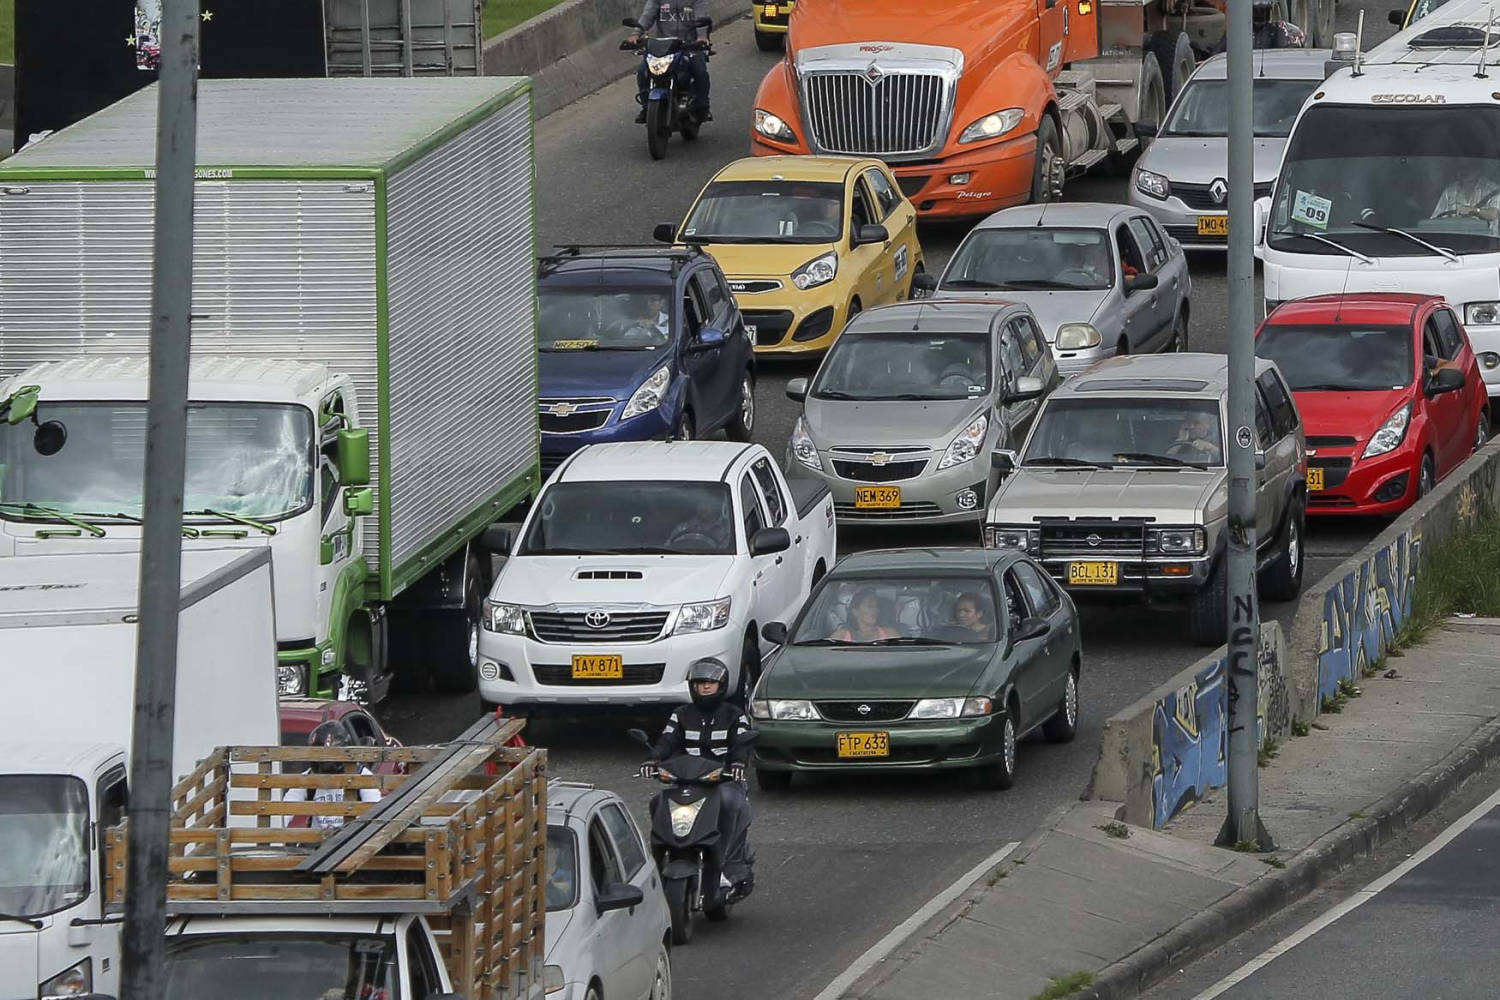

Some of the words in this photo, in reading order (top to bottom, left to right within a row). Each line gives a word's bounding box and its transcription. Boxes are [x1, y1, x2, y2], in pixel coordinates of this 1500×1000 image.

[857, 490, 877, 504] NEM
[879, 490, 899, 503] 369
[1071, 565, 1092, 579] BCL
[1095, 565, 1115, 578] 131
[574, 658, 597, 673] IAY
[598, 658, 620, 673] 871
[839, 737, 861, 752] FTP
[864, 735, 888, 750] 633
